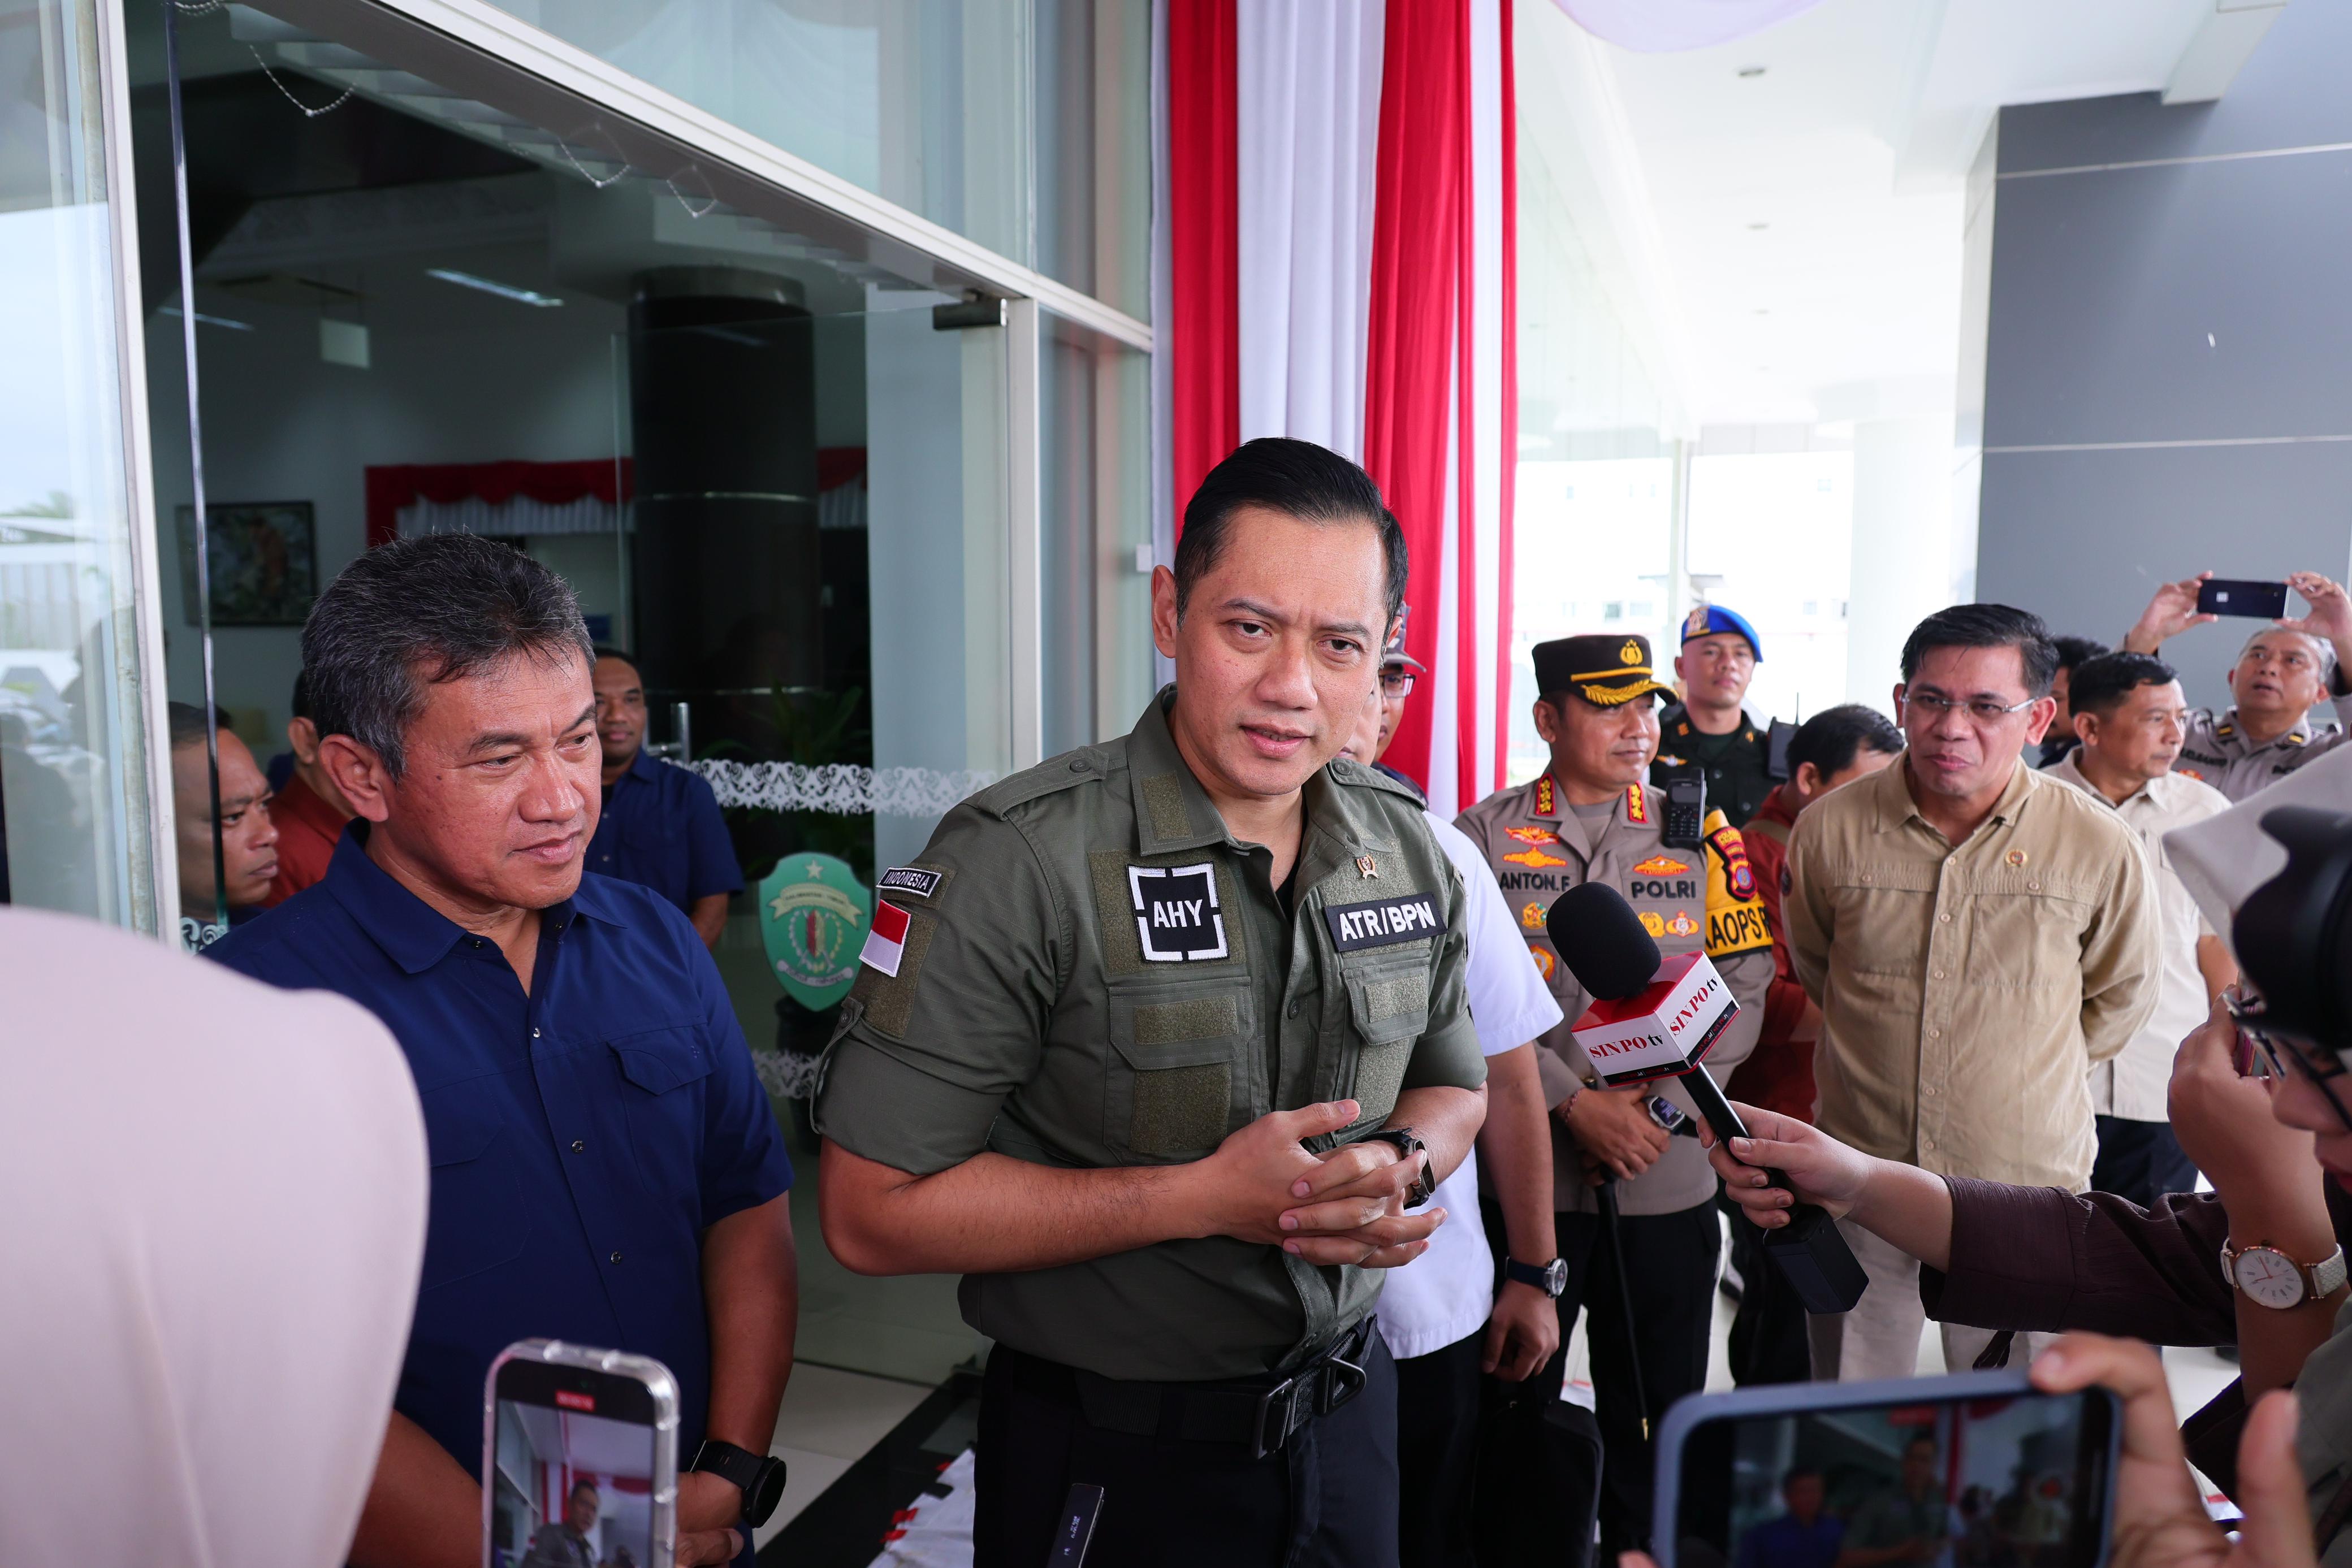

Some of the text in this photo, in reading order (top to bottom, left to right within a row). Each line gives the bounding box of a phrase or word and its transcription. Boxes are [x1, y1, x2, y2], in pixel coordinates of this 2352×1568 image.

[883, 871, 930, 890] INDONESIA
[1499, 871, 1570, 892] ANTON.F
[1631, 880, 1696, 899] POLRI
[1153, 899, 1203, 928] AHY
[1340, 902, 1436, 941] ATR/BPN
[1670, 987, 1709, 1037] SINPO
[1706, 976, 1718, 992] tv
[1589, 1033, 1663, 1059] SINPO tv
